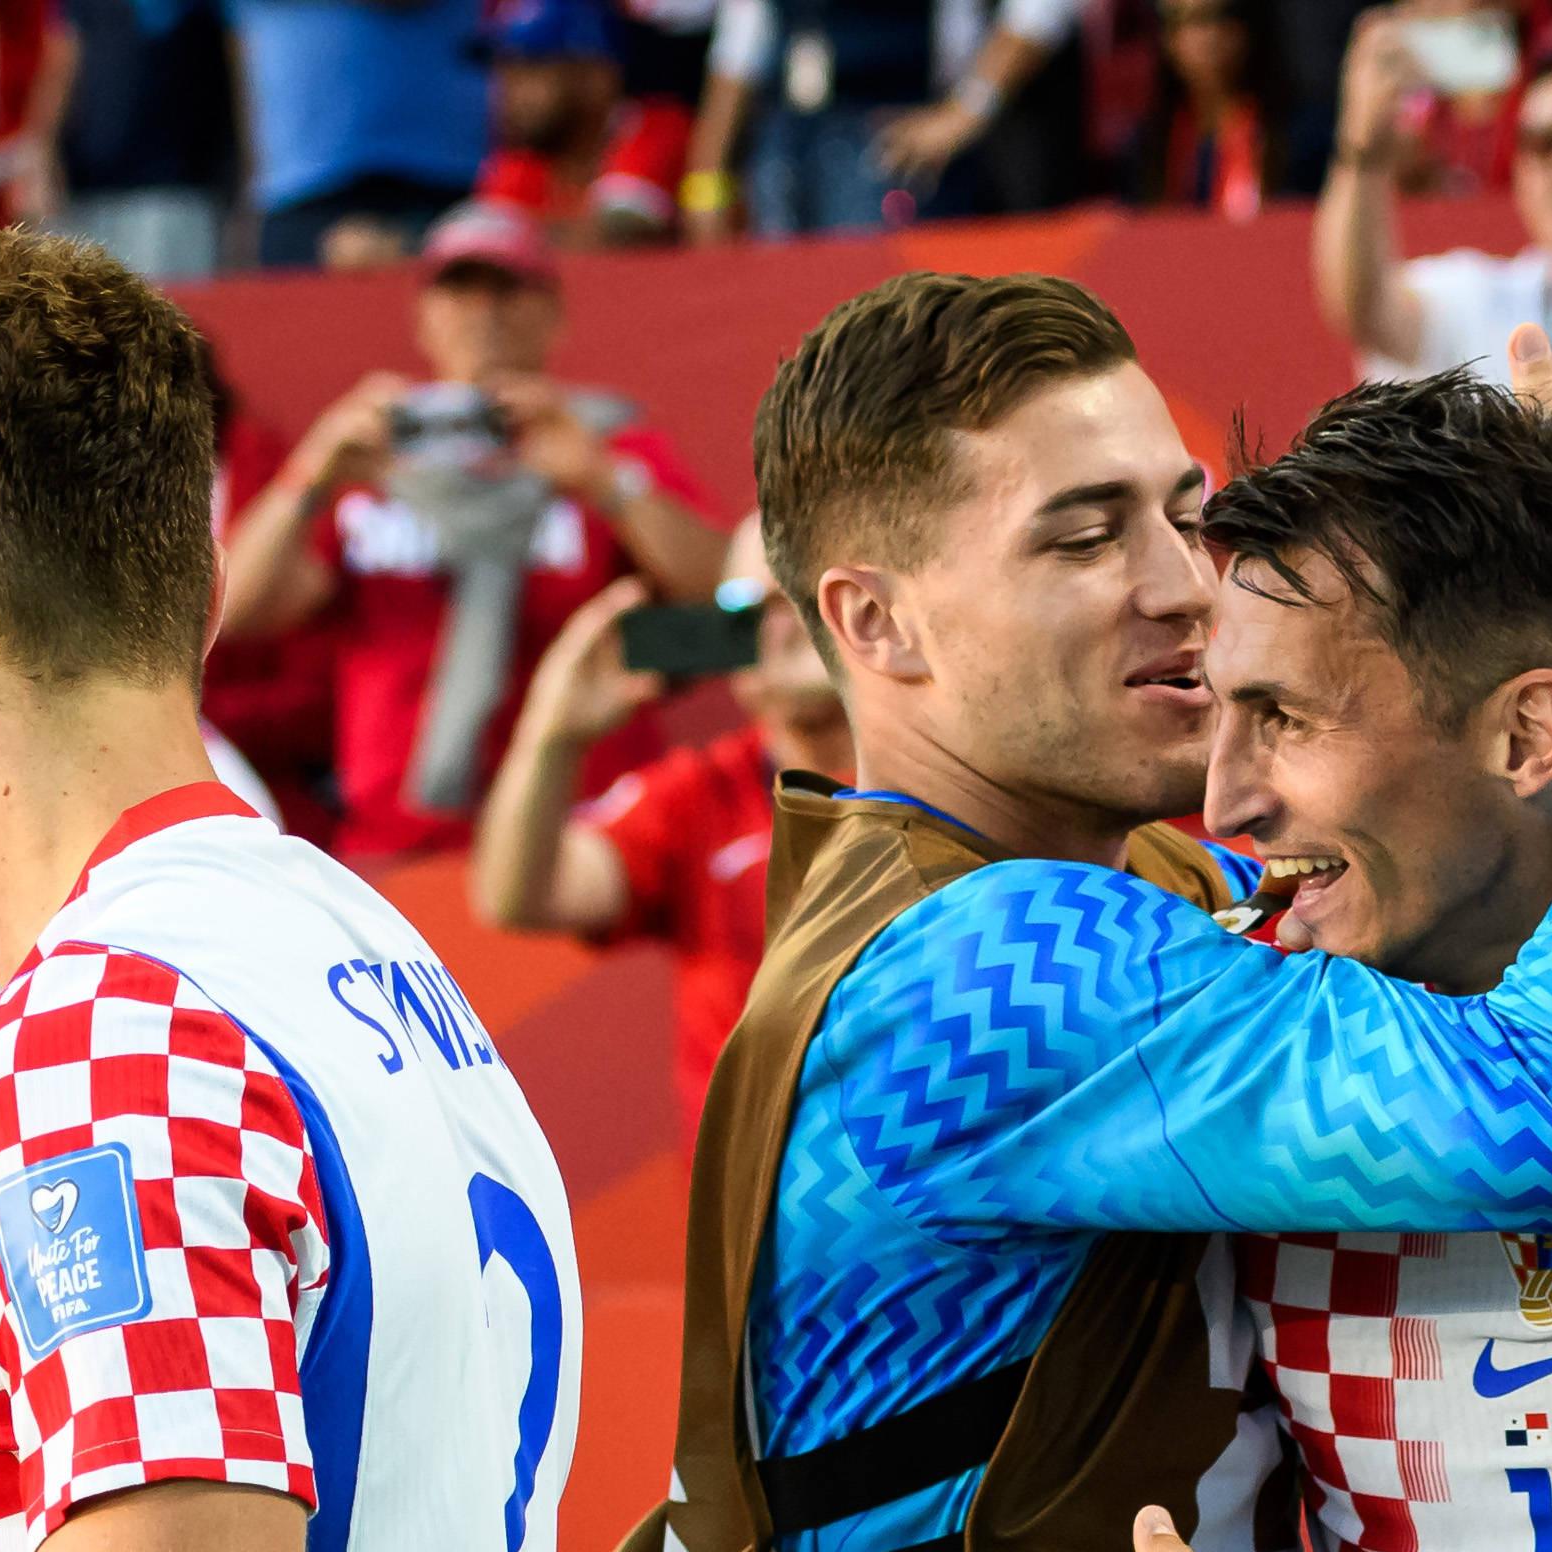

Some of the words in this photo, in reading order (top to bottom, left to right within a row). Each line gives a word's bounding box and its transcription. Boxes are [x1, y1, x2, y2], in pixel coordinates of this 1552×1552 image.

[27, 1239, 71, 1277] Unite
[69, 1226, 100, 1262] For
[35, 1258, 102, 1308] PEACE
[51, 1298, 90, 1323] FIFA
